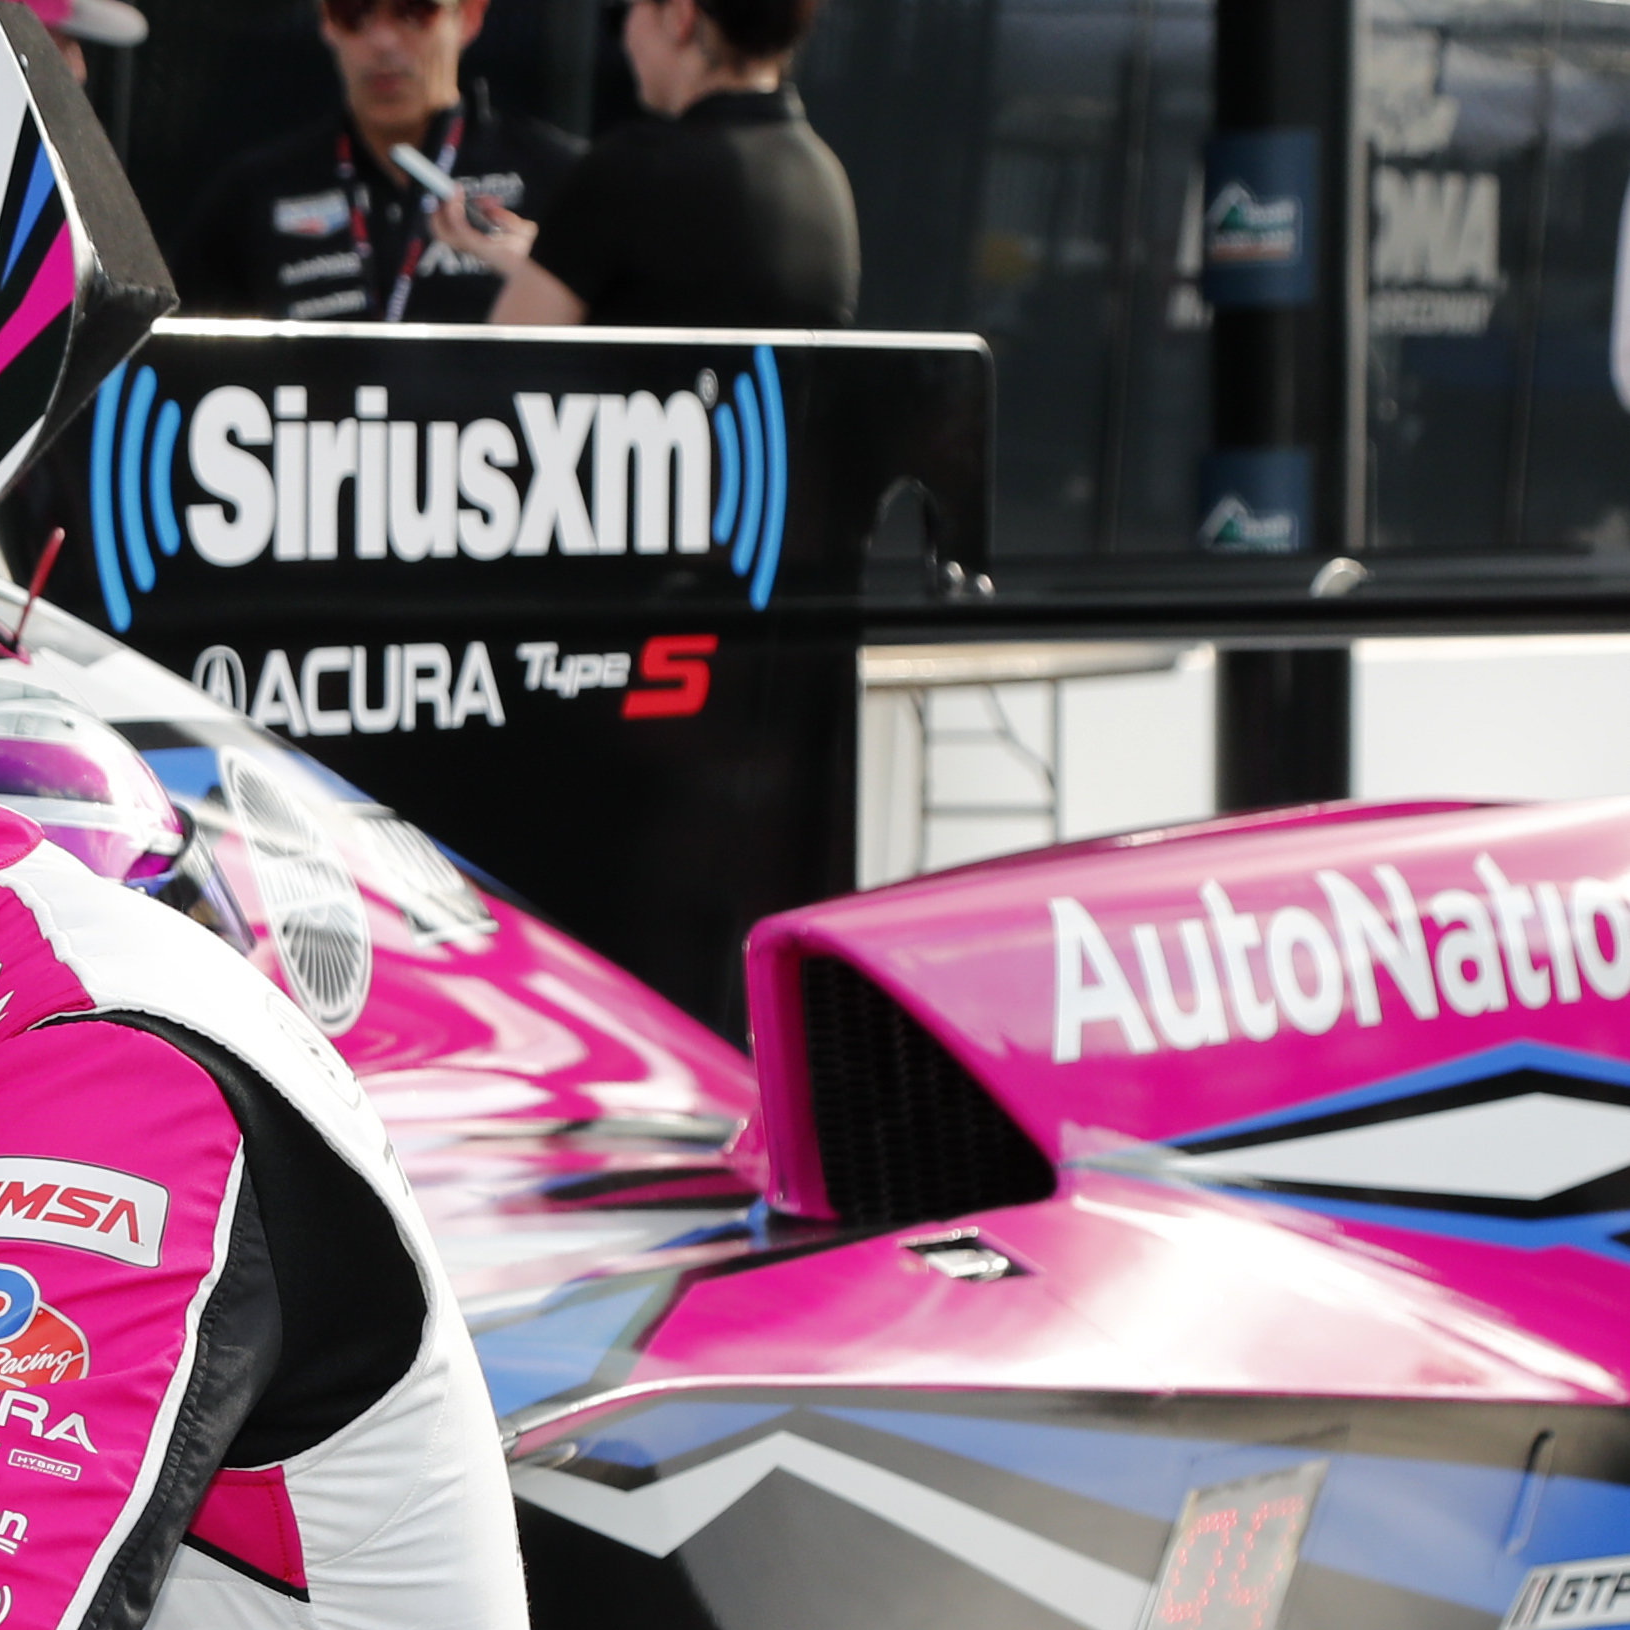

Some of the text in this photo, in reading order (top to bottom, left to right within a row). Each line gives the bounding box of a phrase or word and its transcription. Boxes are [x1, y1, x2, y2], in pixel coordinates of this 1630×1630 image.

[249, 633, 719, 738] ACURA Type S
[16, 1454, 73, 1477] HYBRID
